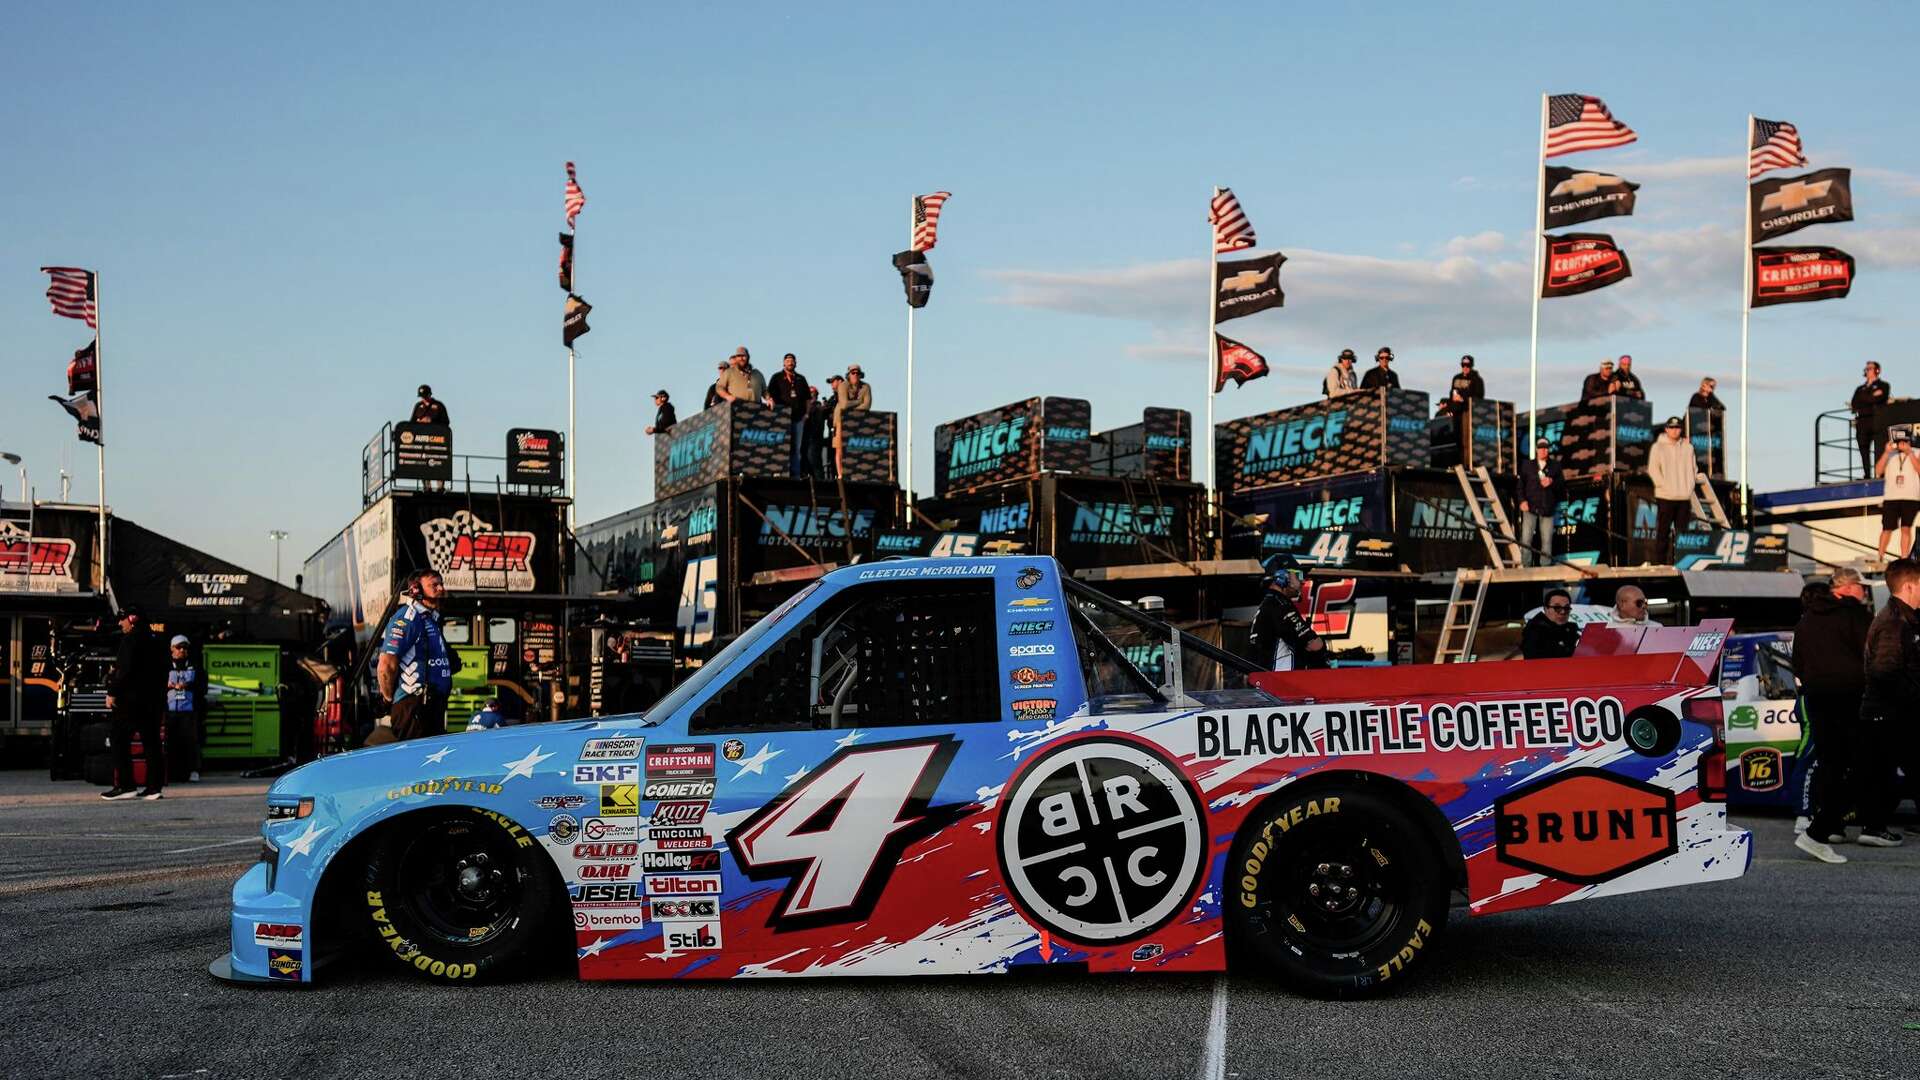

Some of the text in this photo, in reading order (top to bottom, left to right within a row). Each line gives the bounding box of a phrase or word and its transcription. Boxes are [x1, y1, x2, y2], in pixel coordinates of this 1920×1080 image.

[1549, 192, 1628, 213] CHEVROLET
[1761, 205, 1836, 230] CHEVROLET
[1761, 264, 1844, 283] CRAFTSMAN
[1390, 418, 1425, 432] NIECE
[740, 429, 786, 444] NIECE
[1048, 427, 1089, 440] NIECE
[1147, 435, 1185, 448] NIECE
[1247, 411, 1348, 464] NIECE
[669, 425, 716, 467] NIECE
[847, 437, 889, 450] NIECE
[951, 417, 1025, 467] NIECE
[948, 458, 1001, 480] MOTORSPORTS
[1243, 452, 1315, 475] MOTORSPORTS
[760, 504, 876, 538] NIECE
[979, 503, 1029, 533] NIECE
[1072, 502, 1175, 537] NIECE
[1293, 497, 1363, 530] NIECE
[878, 535, 923, 548] NIECE
[1263, 533, 1303, 546] NIECE
[1409, 528, 1475, 541] MOTORSPORTS
[1677, 534, 1709, 548] NIECE
[450, 534, 532, 572] MHR
[930, 534, 978, 557] 45
[1310, 533, 1351, 564] 44
[1715, 531, 1749, 564] 42
[185, 574, 248, 584] WELCOME
[859, 568, 917, 580] CLEETUS
[202, 584, 231, 594] VIP
[186, 596, 244, 606] GARAGE GUEST
[1011, 621, 1054, 632] NIECE
[1689, 633, 1726, 651] NIECE
[212, 660, 271, 669] CARLYLE
[1012, 700, 1057, 710] VICTORY
[1197, 699, 1621, 758] BLACK RIFLE COFFEE CO
[602, 740, 635, 749] NASCAR
[585, 749, 635, 758] RACE TRUCK
[649, 755, 711, 767] CRAFTSMAN
[575, 765, 637, 782] SKF
[1749, 763, 1771, 780] 16
[386, 776, 504, 800] GOODYEAR
[645, 782, 714, 798] COMETIC
[601, 807, 637, 815] KENNAMETAL
[657, 804, 705, 820] KLOTZ
[651, 829, 702, 839] LINCOLN
[736, 742, 927, 916] 4
[1503, 807, 1668, 845] BRUNT
[664, 840, 707, 849] WELDERS
[1241, 797, 1342, 908] GOODYEAR
[644, 852, 692, 871] Holley
[571, 885, 641, 902] JESEL
[649, 878, 718, 893] tilton
[653, 901, 714, 917] KOOKS
[590, 914, 640, 925] brembo
[256, 924, 303, 938] ARP
[366, 890, 478, 979] GOODYEAR
[669, 924, 717, 948] Stilo
[1377, 918, 1433, 982] EAGLE
[270, 959, 303, 970] SUNOCO
